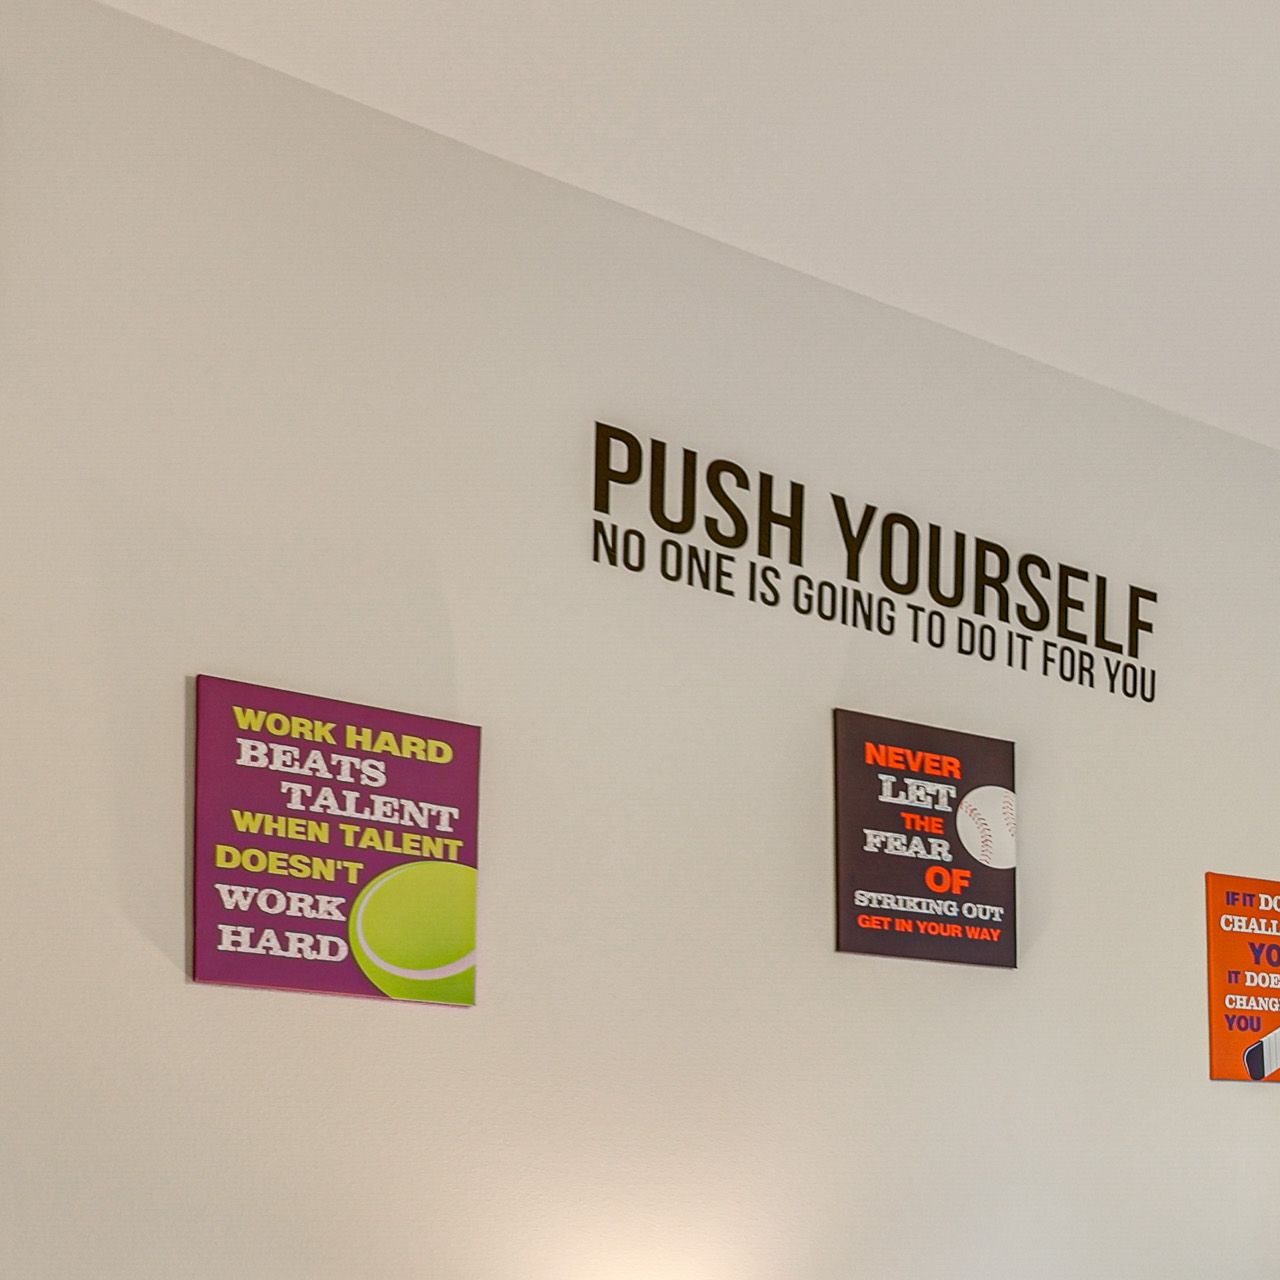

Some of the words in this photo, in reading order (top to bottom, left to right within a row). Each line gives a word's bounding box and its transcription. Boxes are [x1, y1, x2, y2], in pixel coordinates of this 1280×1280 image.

[593, 420, 805, 568] PUSH
[830, 492, 1158, 659] YOURSELF
[592, 519, 645, 573] NO
[660, 539, 736, 597] ONE
[748, 560, 781, 606] IS
[793, 574, 895, 636] GOING
[906, 604, 945, 648] TO
[957, 616, 996, 661] DO
[1006, 630, 1033, 671] IT
[1042, 641, 1095, 688] FOR
[1103, 655, 1156, 703] YOU
[232, 705, 337, 745] WORK
[345, 725, 453, 764] HARD
[235, 737, 387, 788] BEATS
[864, 742, 962, 779] NEVER
[280, 781, 459, 833] TALENT
[877, 773, 957, 813] LET
[231, 809, 329, 843] WHEN
[339, 823, 463, 861] TALENT
[900, 811, 945, 835] THE
[215, 844, 364, 884] DOESN'T
[862, 828, 954, 862] FEAR
[925, 866, 973, 895] OF
[1225, 891, 1240, 906] IF
[1242, 893, 1256, 907] IT
[214, 883, 347, 921] WORK
[854, 890, 960, 917] STRIKING
[962, 902, 1005, 922] OUT
[217, 923, 349, 962] HARD
[857, 914, 892, 931] GET
[895, 918, 913, 932] IN
[916, 919, 963, 938] YOUR
[965, 926, 1002, 942] WAY
[1227, 970, 1241, 984] IT
[1224, 1014, 1262, 1033] YOU
